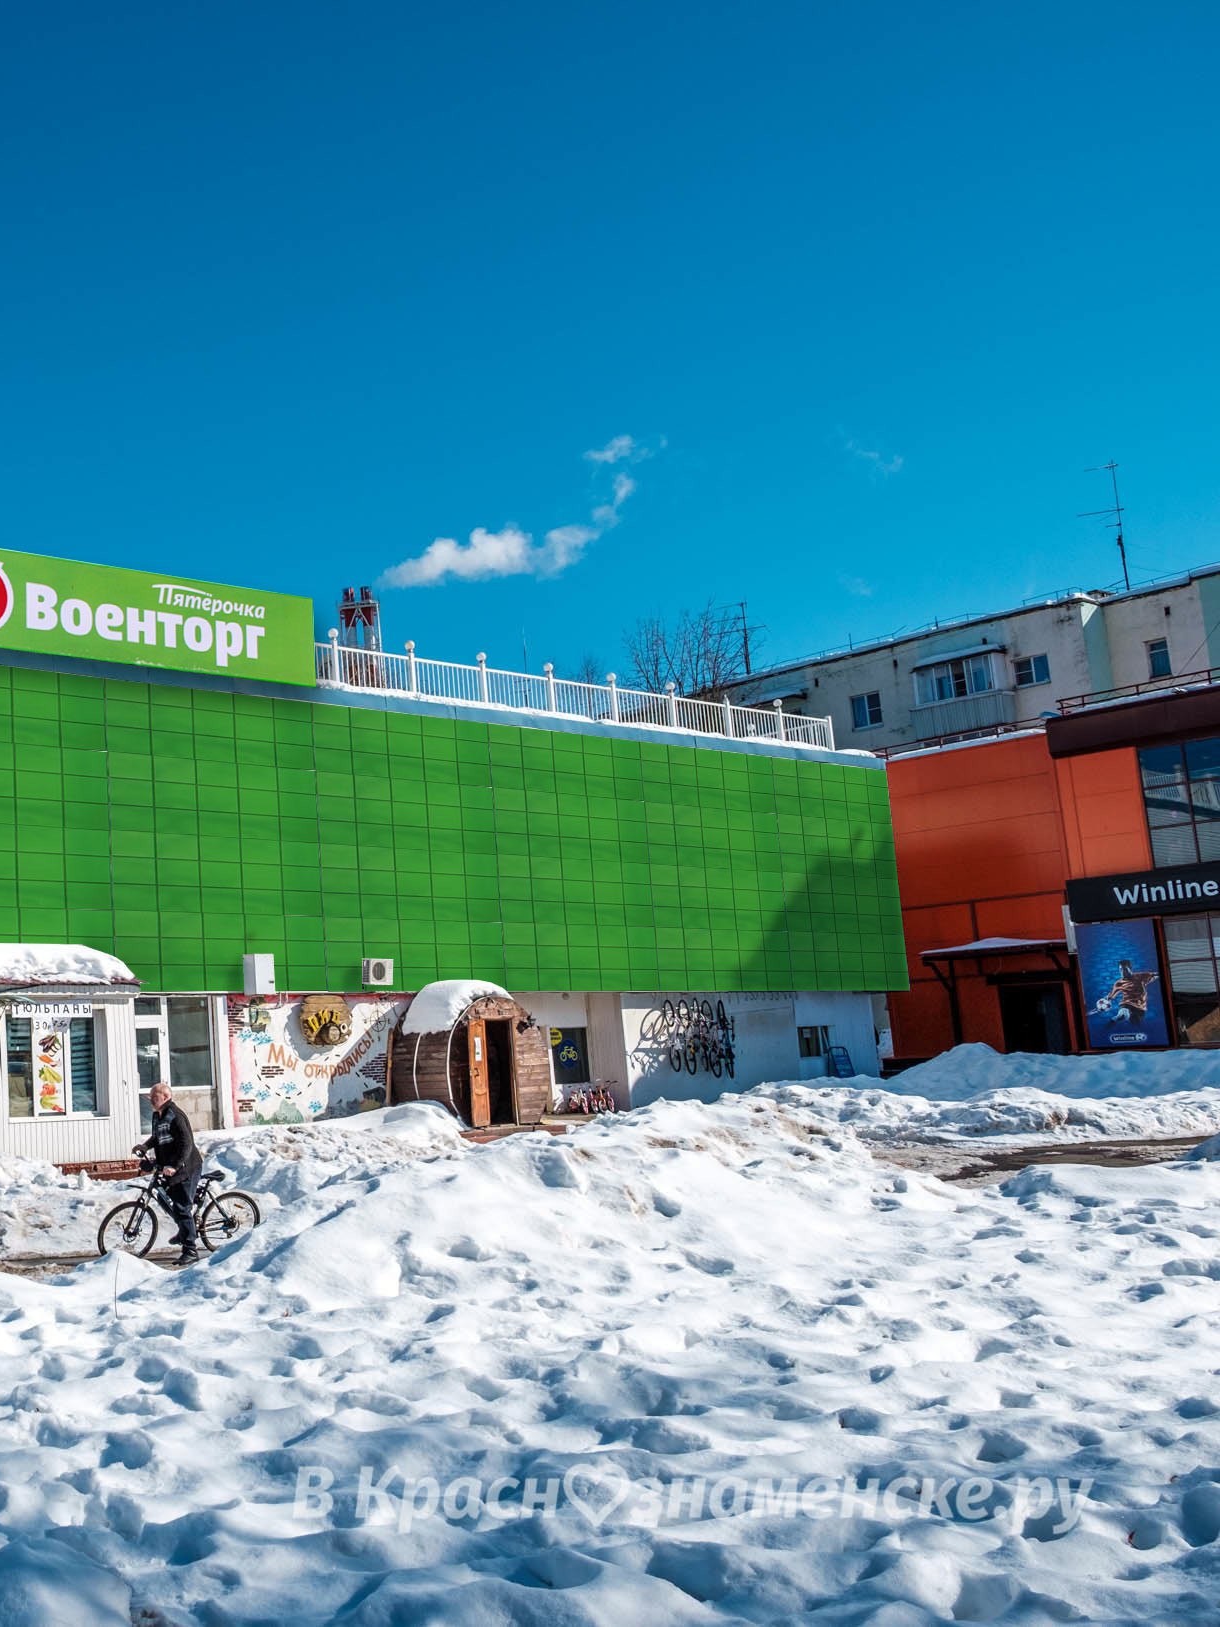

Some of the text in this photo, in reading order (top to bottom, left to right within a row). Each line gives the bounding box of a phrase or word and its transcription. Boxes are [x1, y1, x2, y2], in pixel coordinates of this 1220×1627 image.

[152, 584, 265, 619] Пятёрочка
[26, 582, 265, 667] Военторг
[1113, 879, 1219, 905] Winline
[13, 1003, 91, 1014] ТЮЛЬПАНЫ
[268, 1043, 298, 1071] Мы
